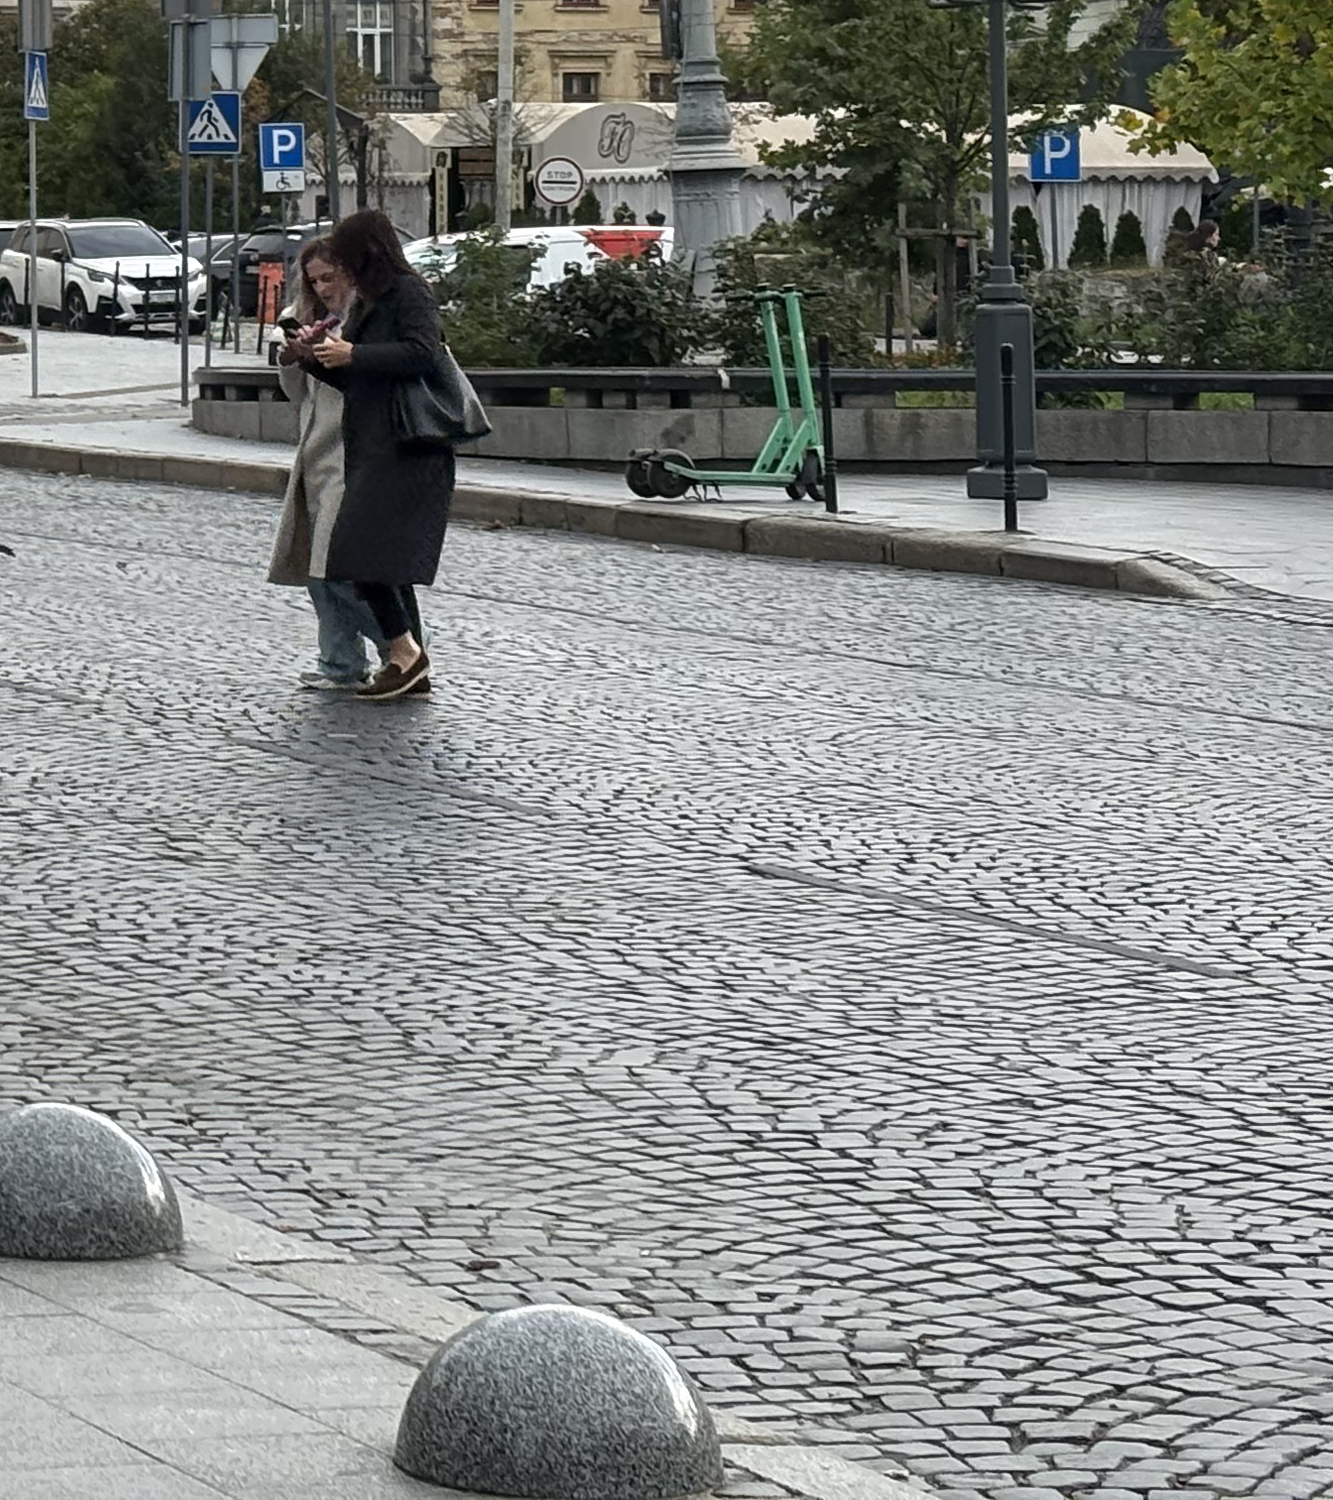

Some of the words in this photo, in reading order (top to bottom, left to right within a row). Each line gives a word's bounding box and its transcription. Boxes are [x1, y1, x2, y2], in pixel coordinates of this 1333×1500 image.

[272, 129, 296, 164] P
[1044, 132, 1071, 174] P
[546, 170, 573, 179] STOP
